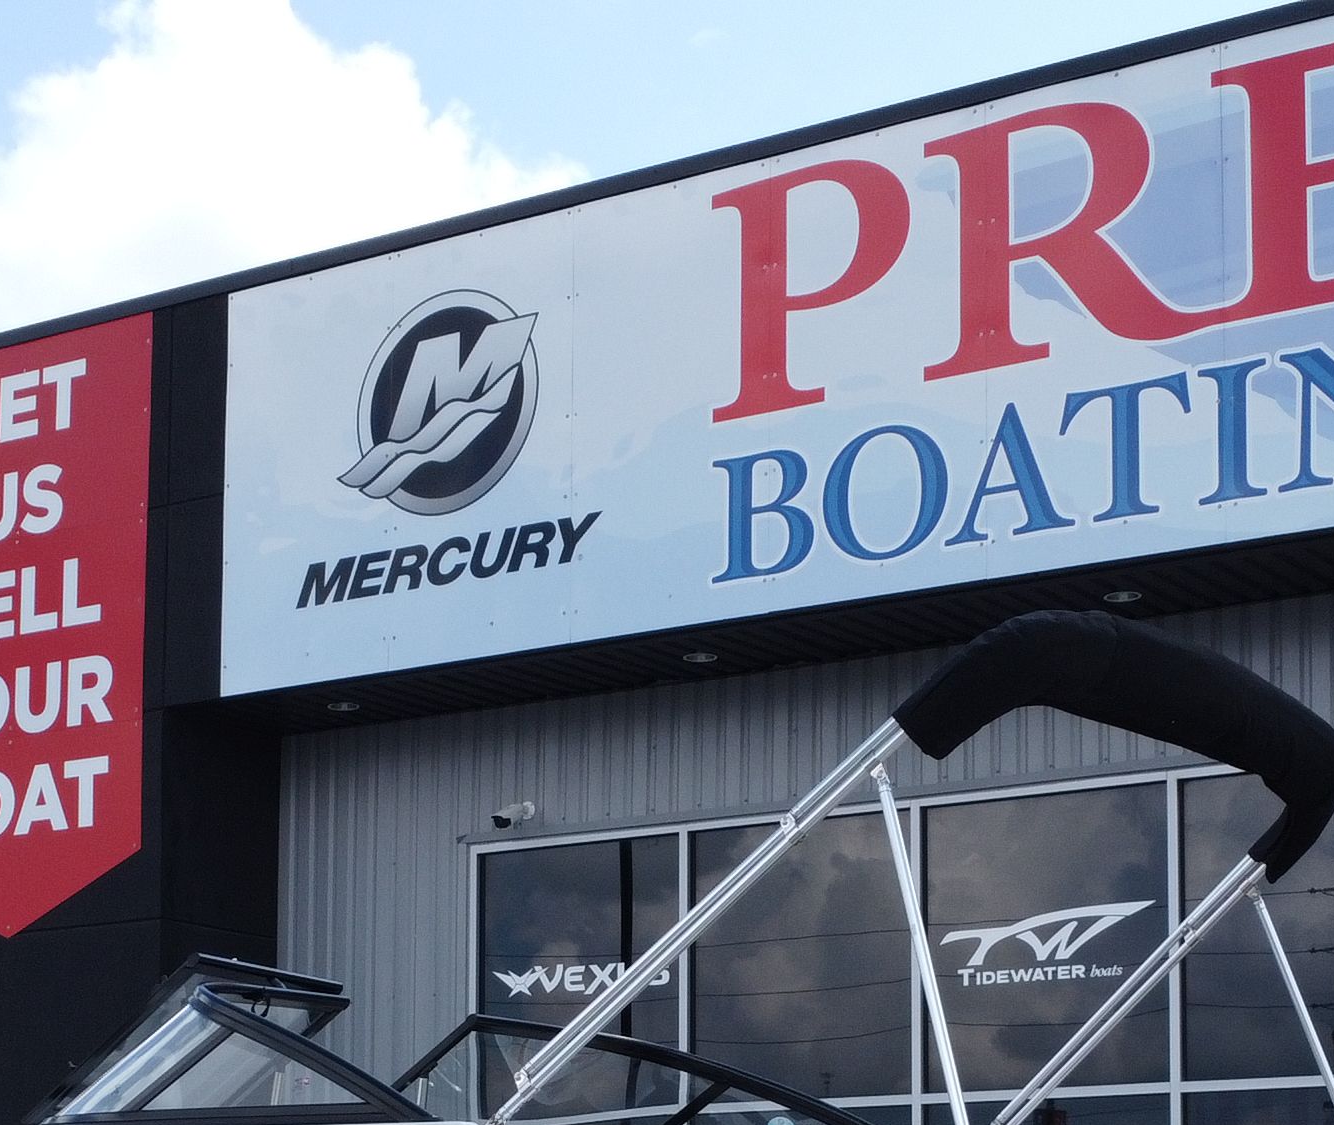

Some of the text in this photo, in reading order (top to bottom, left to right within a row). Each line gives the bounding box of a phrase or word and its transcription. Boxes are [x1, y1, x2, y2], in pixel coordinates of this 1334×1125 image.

[295, 510, 602, 609] MERCURY
[534, 961, 671, 996] VEX
[1089, 963, 1124, 978] boats
